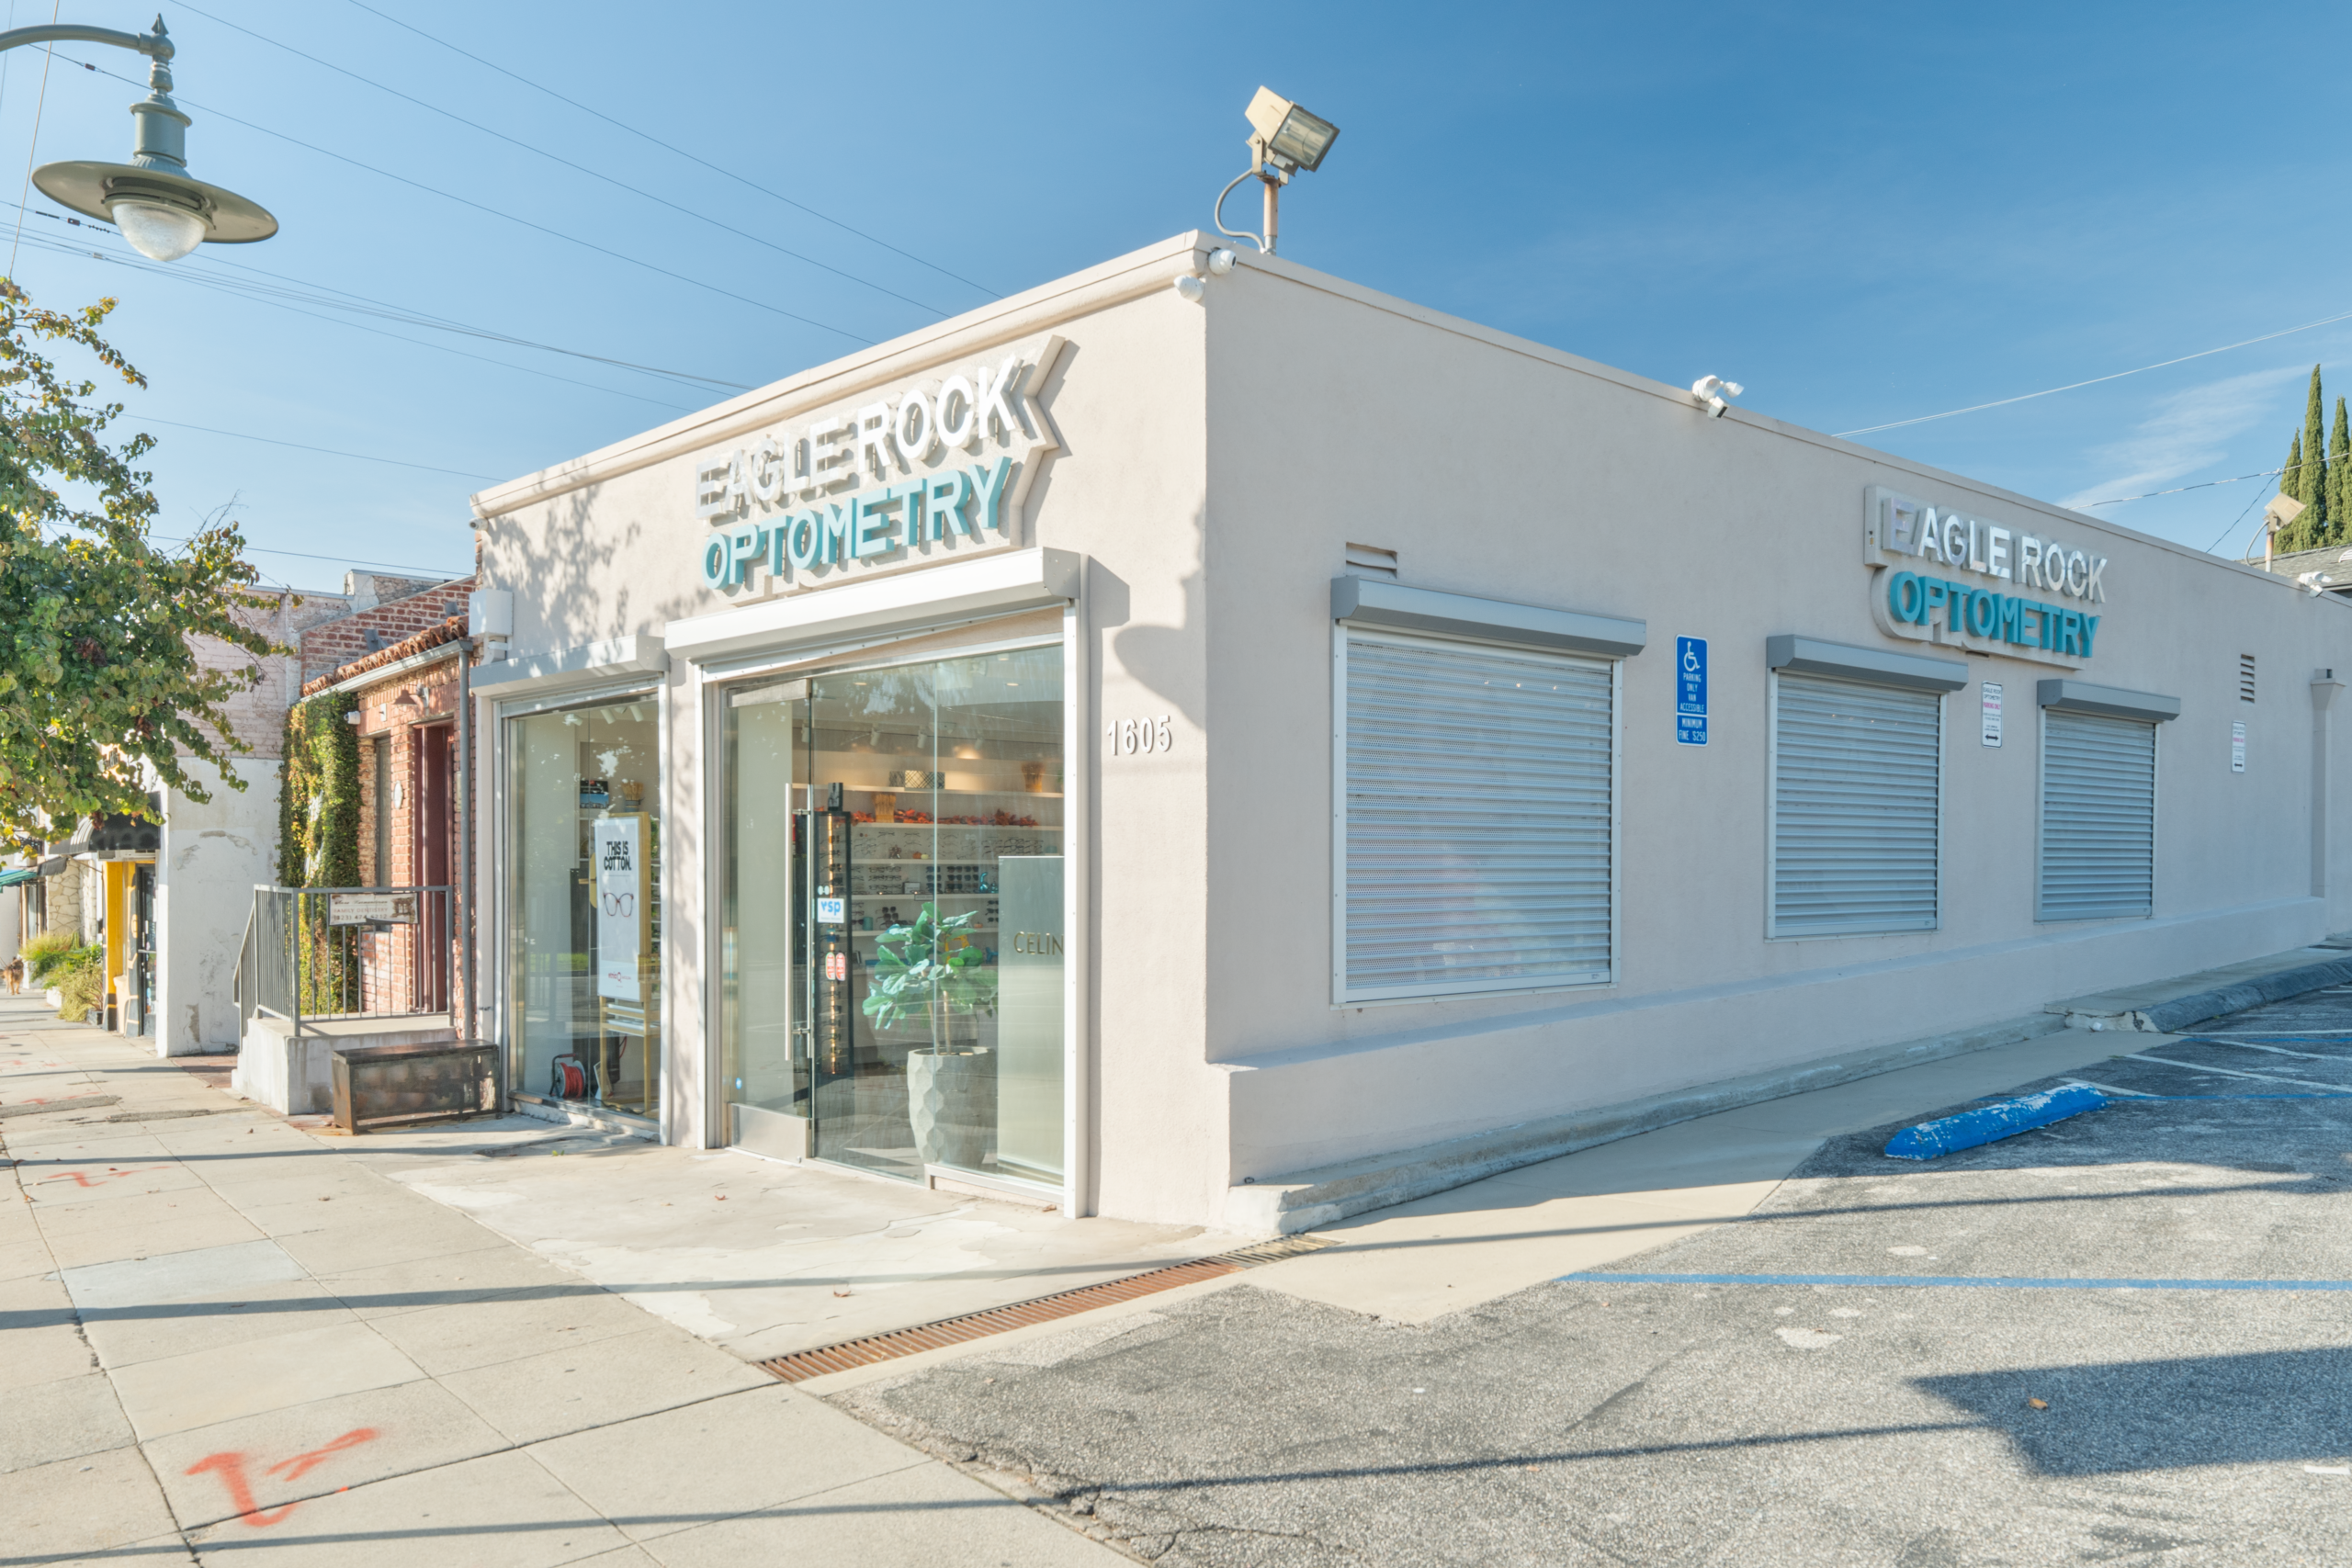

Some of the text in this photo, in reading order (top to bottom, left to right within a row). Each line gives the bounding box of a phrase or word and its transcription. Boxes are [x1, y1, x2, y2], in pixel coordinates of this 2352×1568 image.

[695, 354, 1023, 520] EAGLE ROCK
[701, 456, 1012, 591] OPTOMETRY
[1883, 497, 2109, 604] EAGLE ROCK
[1890, 570, 2101, 659] OPTOMETRY
[1683, 672, 1702, 682] PARKING
[1687, 682, 1698, 692] ONLY
[1688, 693, 1697, 702] VAN
[1679, 703, 1704, 713] ACCESSIBLE
[1681, 717, 1702, 728] MINIMUM
[1107, 715, 1172, 756] 1605
[1679, 729, 1706, 741] FINE $250
[606, 840, 628, 855] THIS IS
[604, 856, 632, 871] COTTON.
[820, 901, 841, 916] vsp
